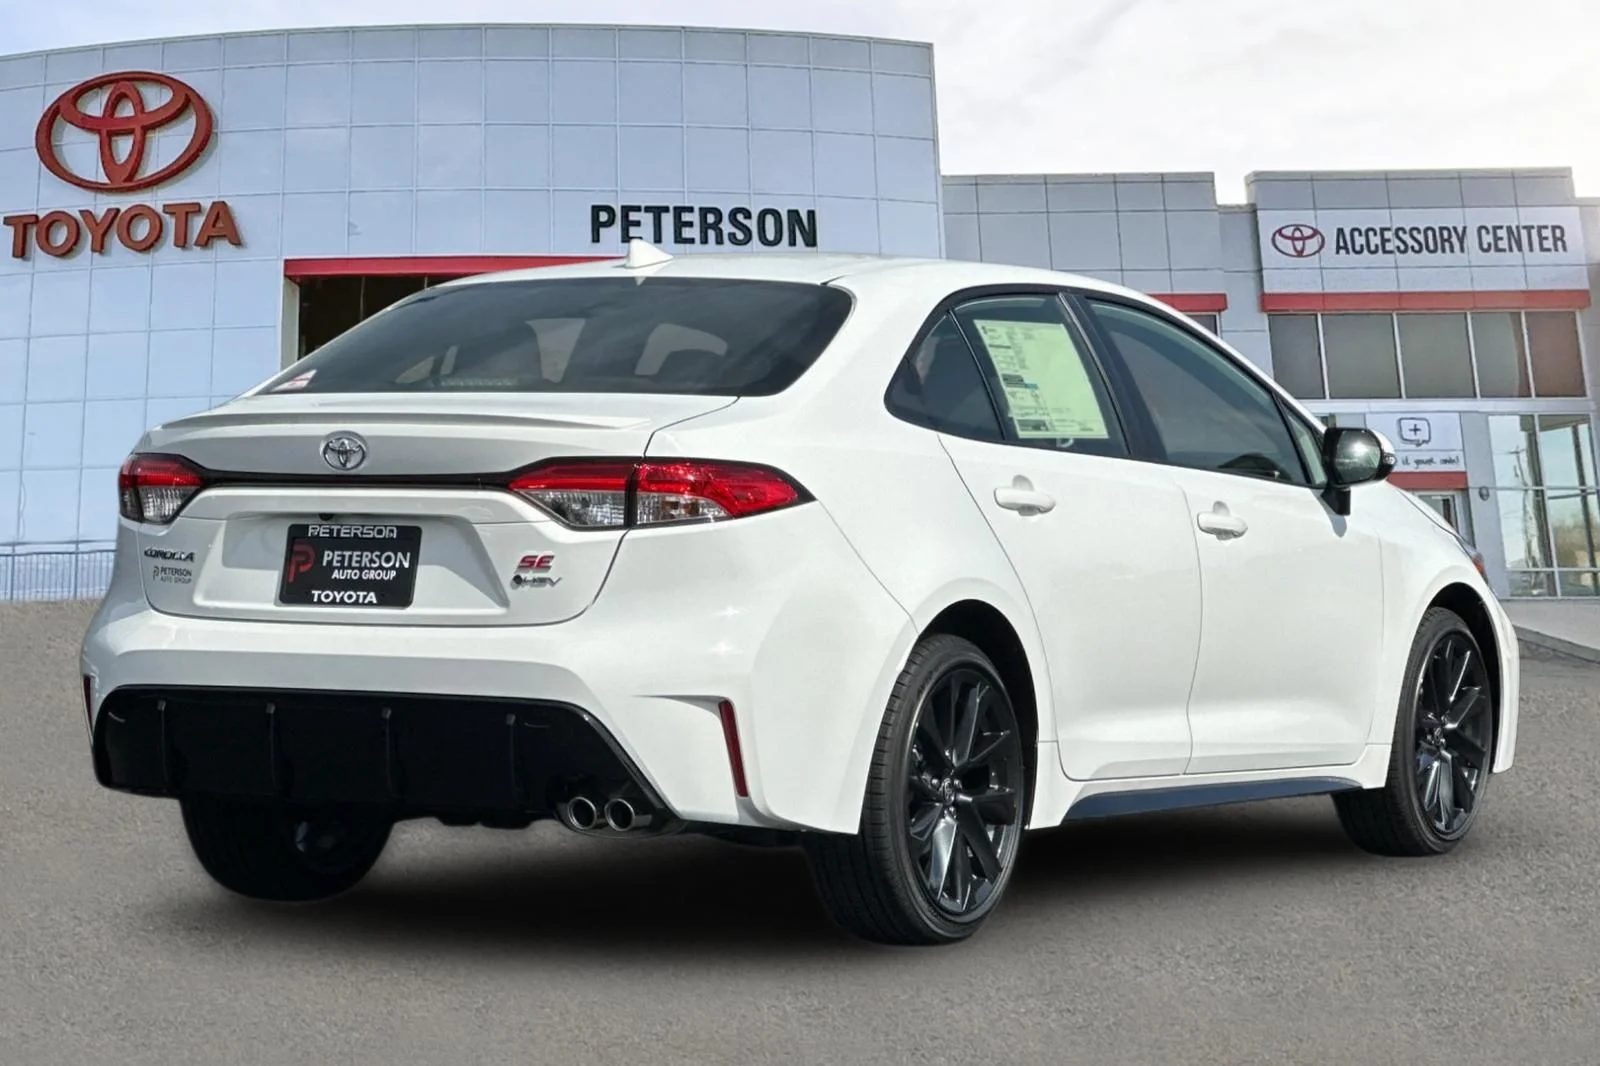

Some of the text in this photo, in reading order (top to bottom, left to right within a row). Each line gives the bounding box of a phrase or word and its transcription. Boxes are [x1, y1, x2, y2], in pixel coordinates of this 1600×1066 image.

[3, 201, 243, 258] TOYOTA
[591, 204, 818, 248] PETERSON
[1335, 224, 1568, 255] ACCESSORY CENTER
[307, 524, 398, 539] PETERSON
[143, 549, 196, 563] COROLLA
[322, 550, 412, 569] PETERSON
[517, 554, 556, 571] SE
[331, 569, 397, 581] AUTO GROUP
[311, 589, 378, 604] TOYOTA
